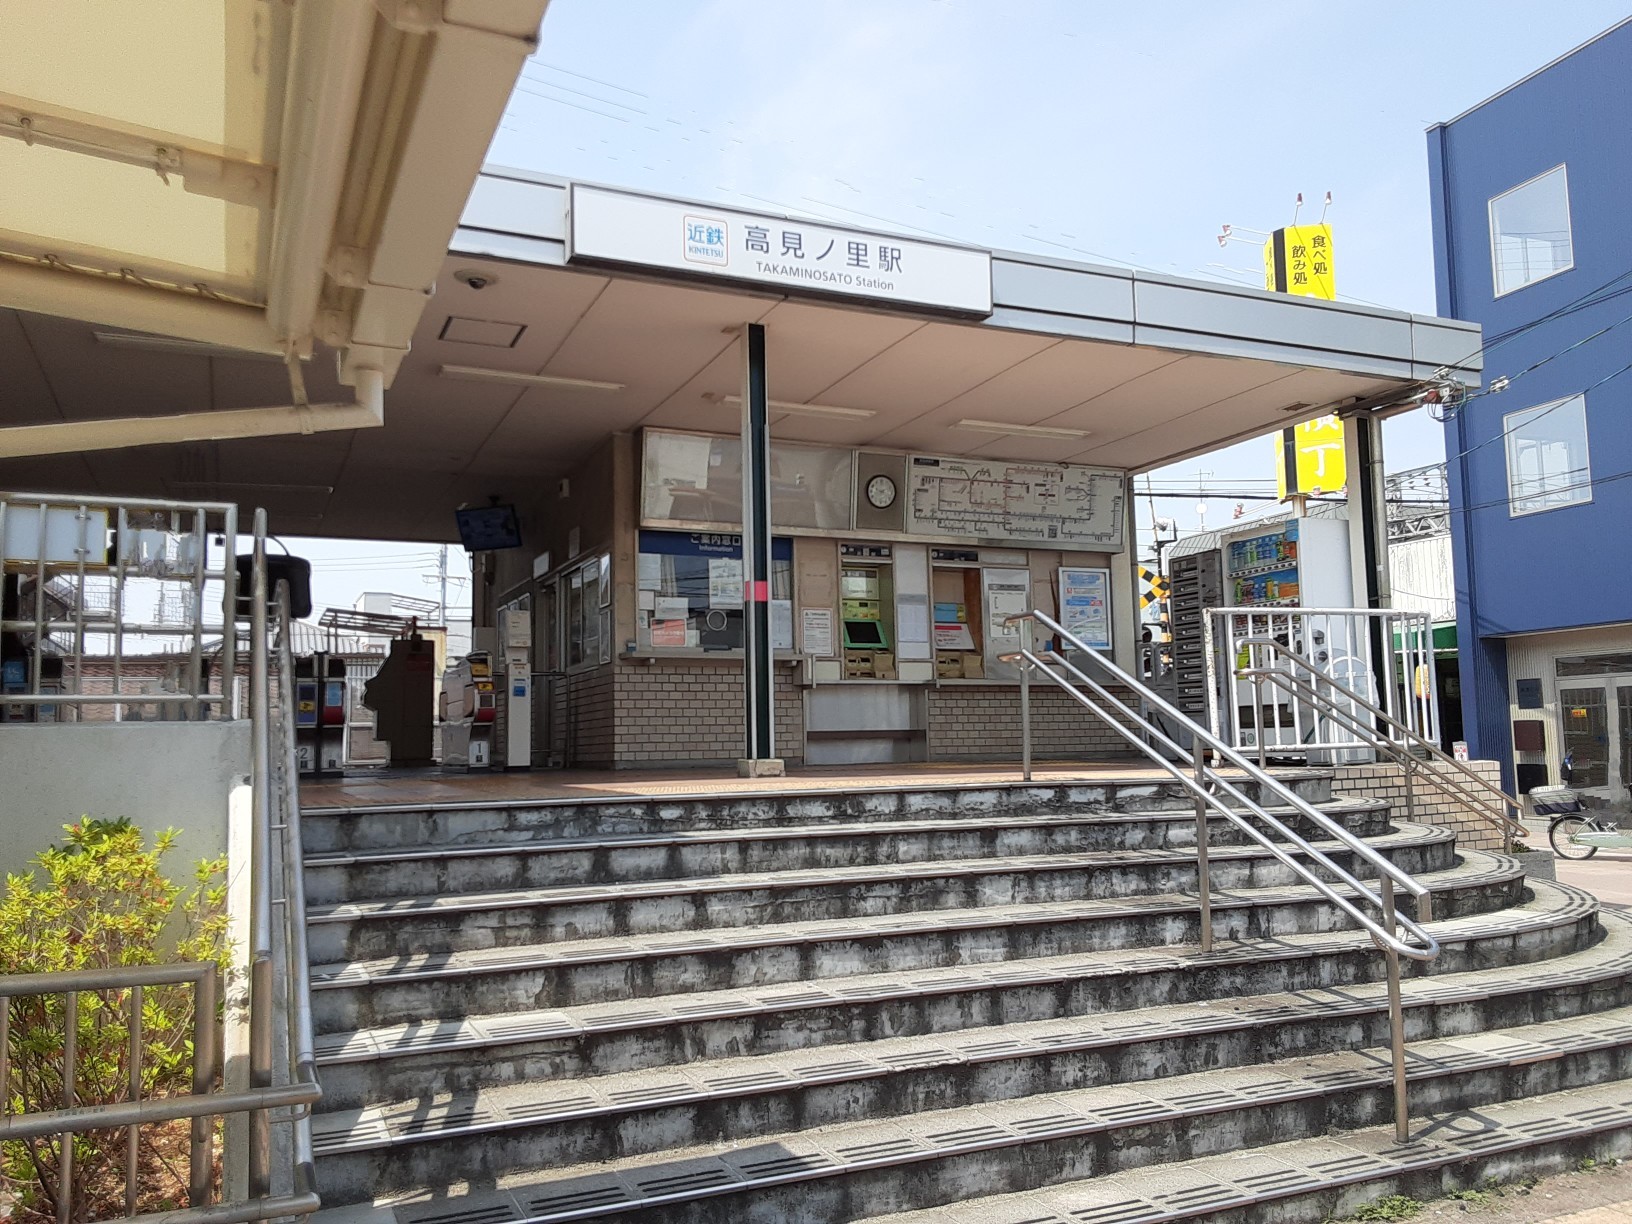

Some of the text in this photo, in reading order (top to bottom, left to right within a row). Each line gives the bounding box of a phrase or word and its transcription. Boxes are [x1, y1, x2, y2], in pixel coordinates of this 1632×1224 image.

[688, 222, 724, 247] 近鉄
[688, 245, 724, 259] KINTETSU
[744, 225, 903, 273] 高見ノ里駅
[1311, 235, 1328, 275] 食べ処
[756, 260, 894, 291] TAKAMINOSATO Station
[1291, 245, 1308, 285] 飲み処
[691, 534, 741, 546] ご案内窓口
[300, 747, 308, 759] 2
[476, 743, 482, 754] 1
